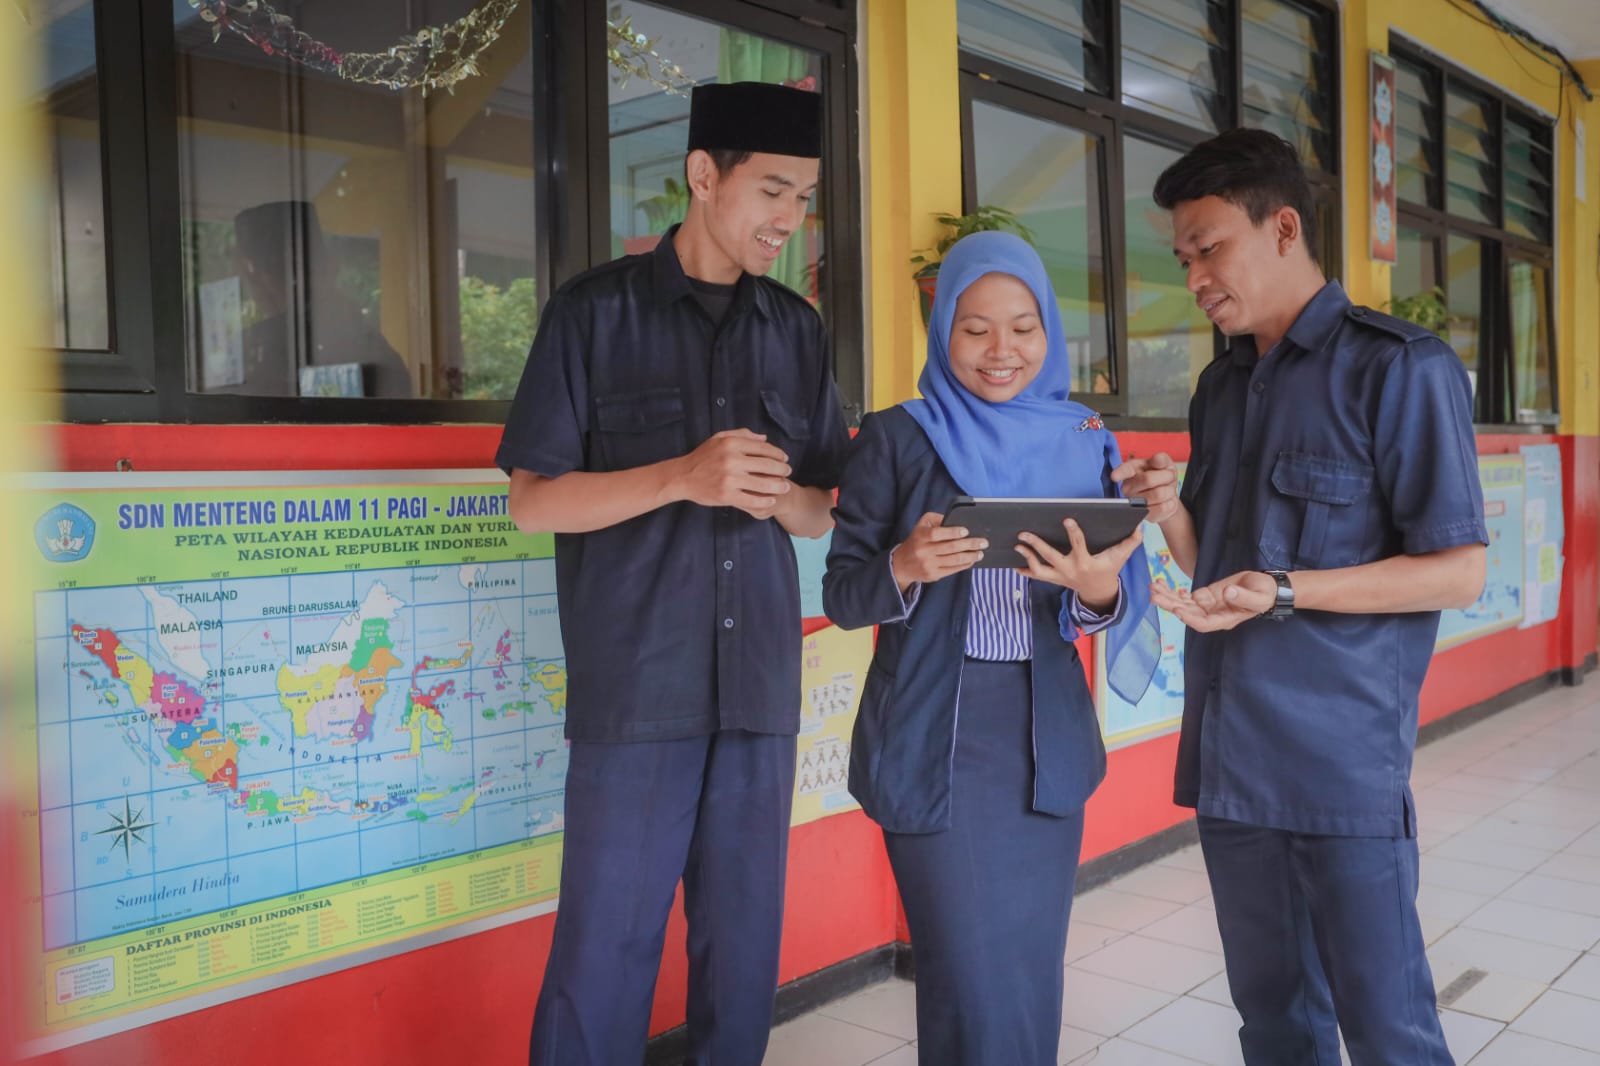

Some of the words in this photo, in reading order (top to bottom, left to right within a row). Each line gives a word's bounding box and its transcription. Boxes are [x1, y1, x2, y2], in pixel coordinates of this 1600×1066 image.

[118, 503, 165, 530] SDN
[173, 500, 276, 528] MENTENG
[284, 498, 351, 523] DALAM
[358, 497, 379, 521] 11
[387, 496, 428, 519] PAGI
[446, 494, 509, 518] JAKART
[175, 533, 227, 547] PETA
[232, 529, 317, 545] WILAYAH
[324, 524, 436, 540] KEDAULATAN
[441, 522, 472, 535] DAN
[237, 545, 330, 562] NASIONAL
[335, 541, 419, 557] REPUBLIK
[424, 536, 508, 551] INDONESIA
[468, 578, 516, 588] PHILIPINA
[177, 590, 238, 604] THAILAND
[262, 604, 296, 616] BRUNEI
[298, 600, 358, 613] DARUSSALAM
[160, 619, 223, 635] MALAYSIA
[296, 641, 348, 656] MALAYSIA
[206, 663, 275, 679] SINGAPURA
[131, 705, 200, 723] SUMATERA
[261, 814, 290, 829] JAWA
[115, 885, 186, 911] Samudera
[192, 873, 241, 894] Hindia
[126, 932, 181, 956] DAFTAR
[185, 918, 247, 942] PROVINSI
[249, 915, 263, 927] DI
[265, 898, 332, 922] INDONESIA
